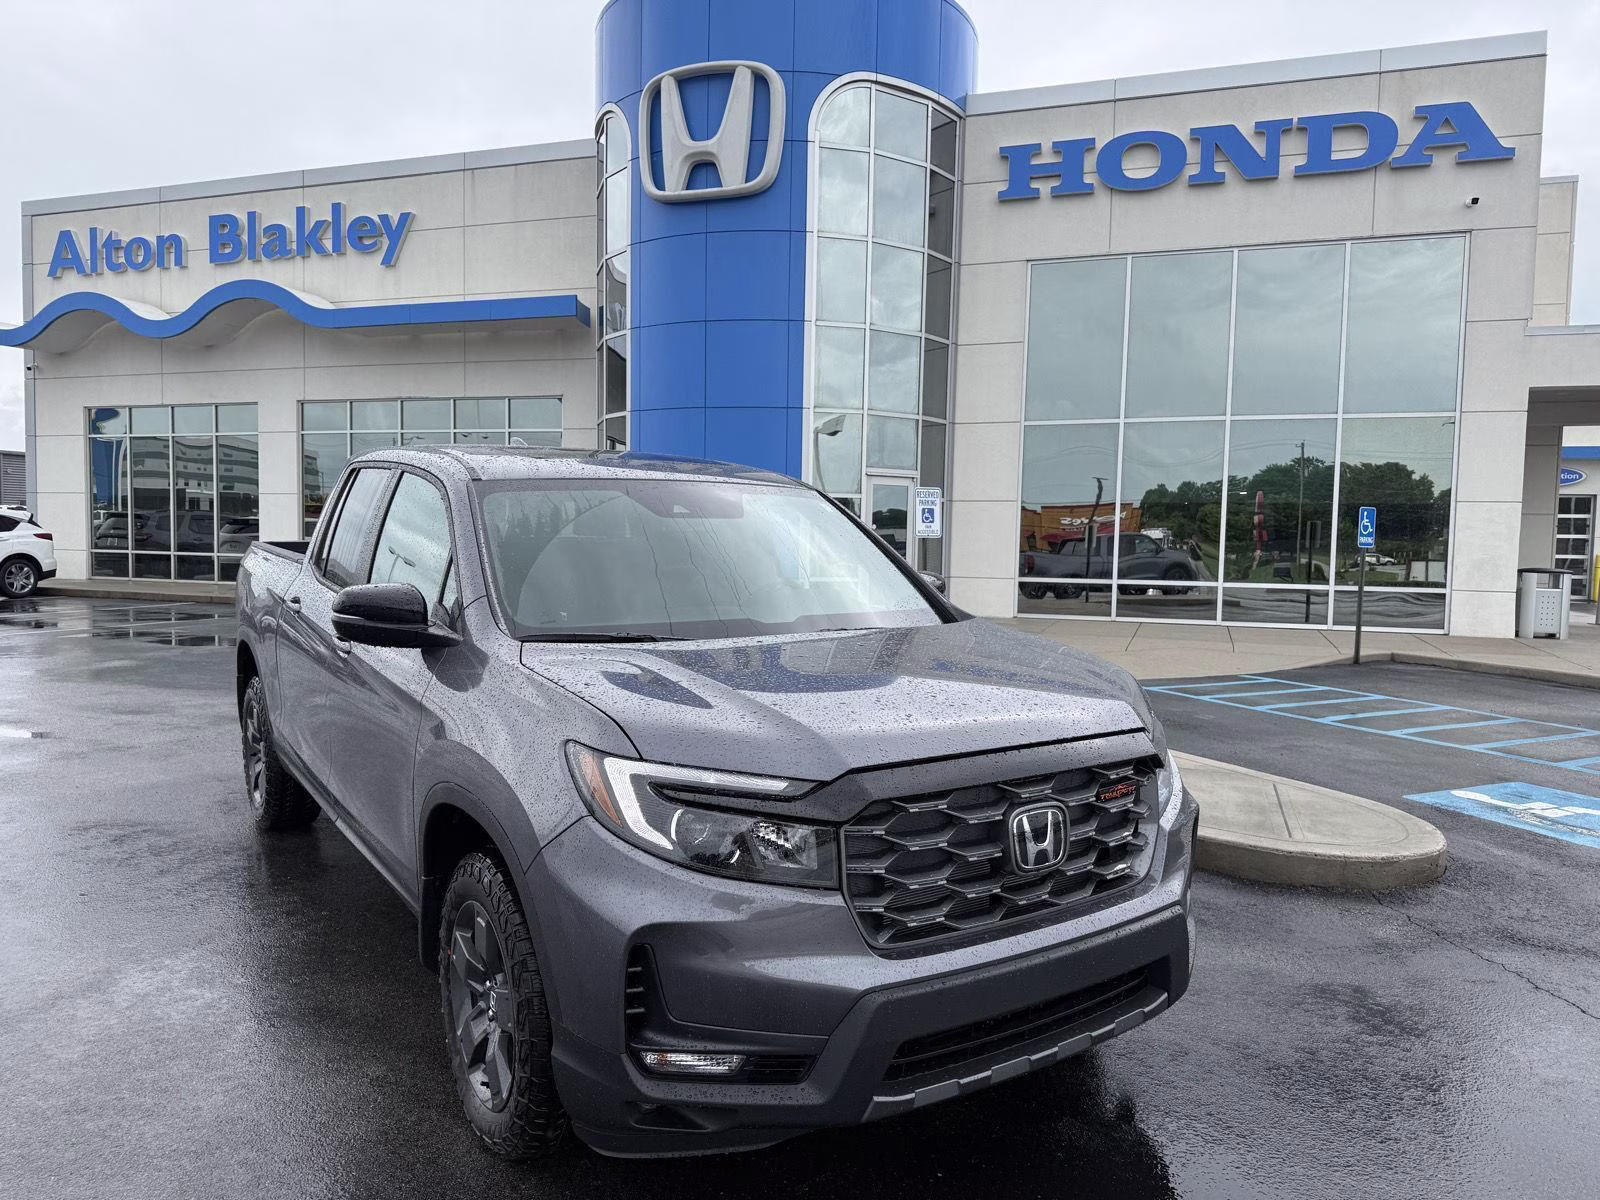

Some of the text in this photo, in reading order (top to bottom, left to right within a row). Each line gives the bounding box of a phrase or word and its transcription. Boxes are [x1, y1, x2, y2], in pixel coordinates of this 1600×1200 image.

[997, 101, 1516, 201] HONDA
[47, 202, 414, 278] Alton Blakley
[916, 490, 938, 498] RESERVED
